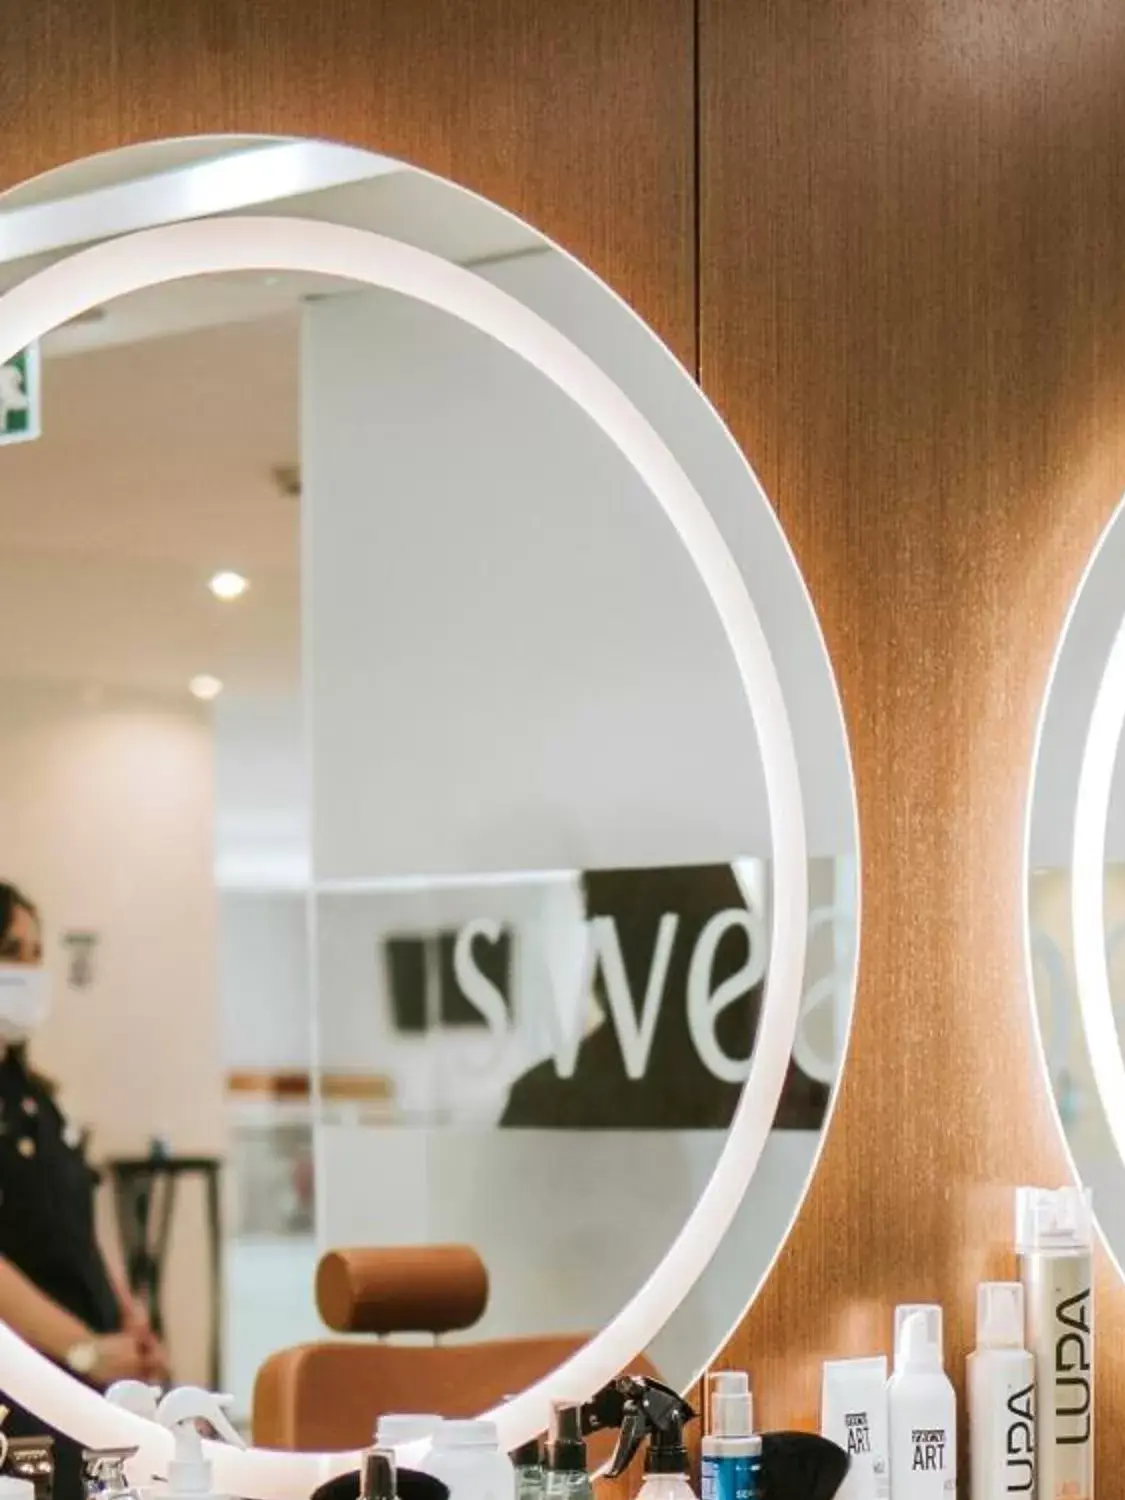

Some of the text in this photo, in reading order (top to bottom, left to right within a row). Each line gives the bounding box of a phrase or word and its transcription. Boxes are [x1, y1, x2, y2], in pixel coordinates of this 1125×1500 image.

[1055, 1288, 1091, 1446] LUPA
[847, 1427, 871, 1454] ART
[911, 1443, 945, 1471] ART
